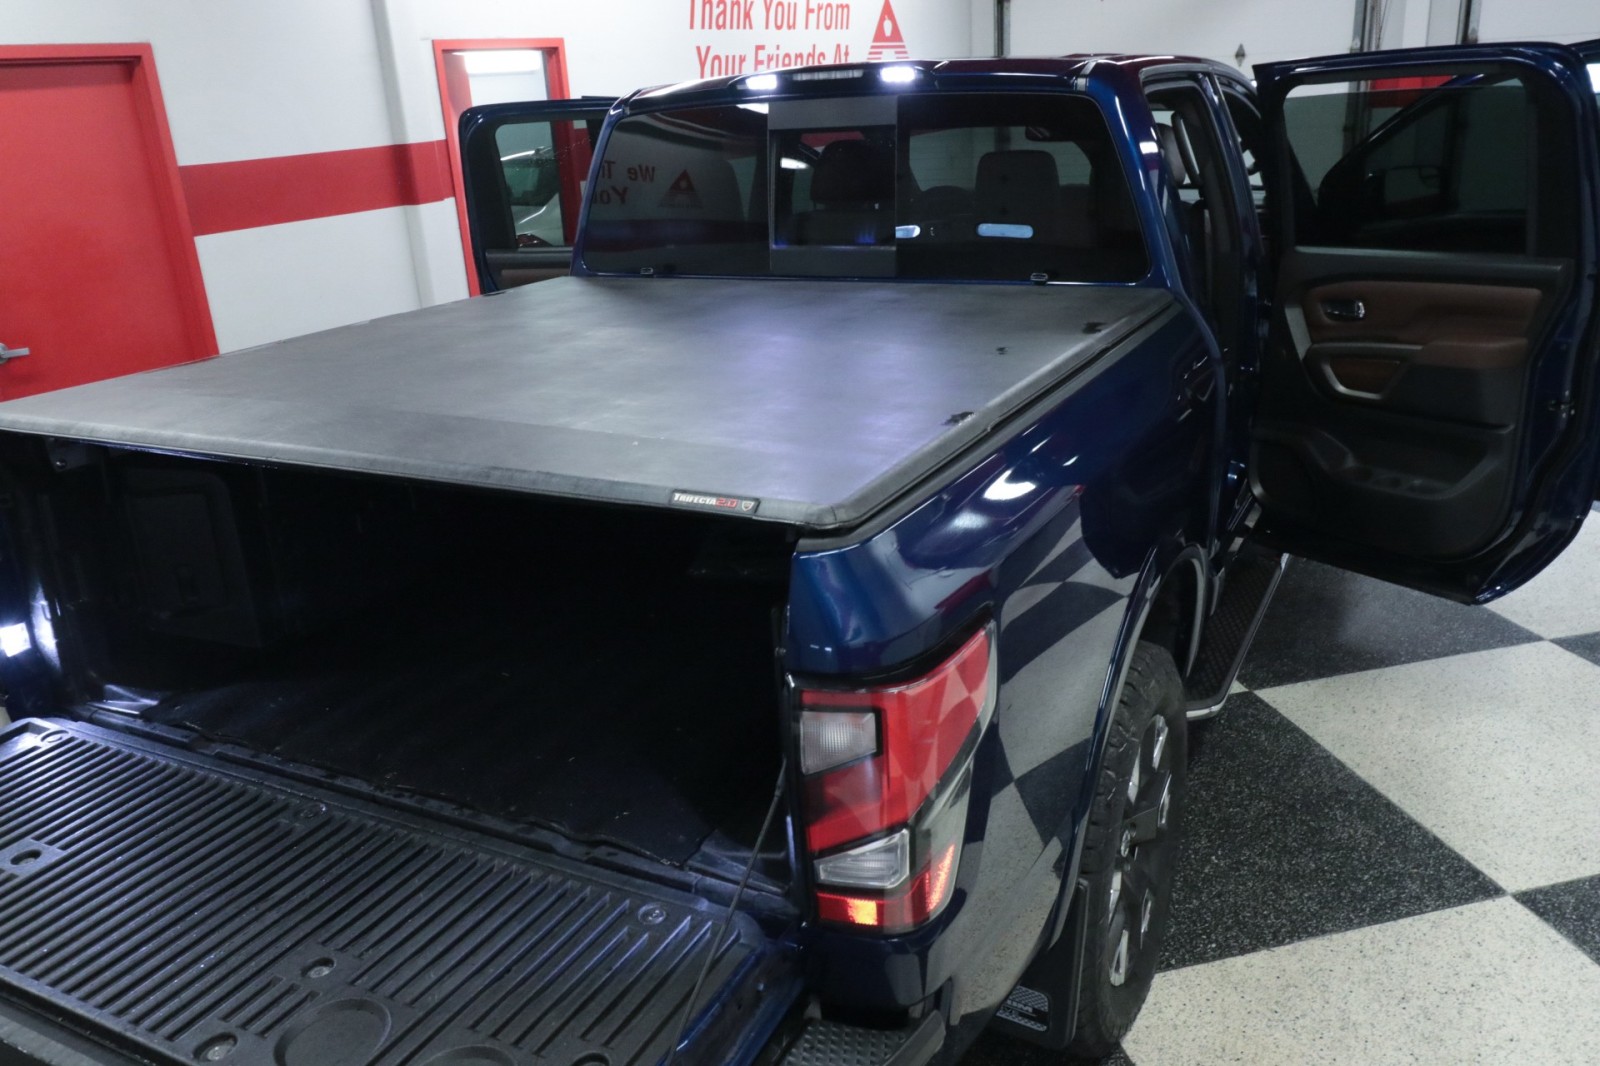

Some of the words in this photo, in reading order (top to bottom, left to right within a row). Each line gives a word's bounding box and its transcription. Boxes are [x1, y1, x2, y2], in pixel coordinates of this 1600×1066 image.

[689, 0, 754, 30] Thank
[763, 0, 797, 30] You
[805, 0, 850, 30] From
[695, 45, 746, 79] Your
[754, 43, 826, 72] Friends
[833, 43, 850, 65] At
